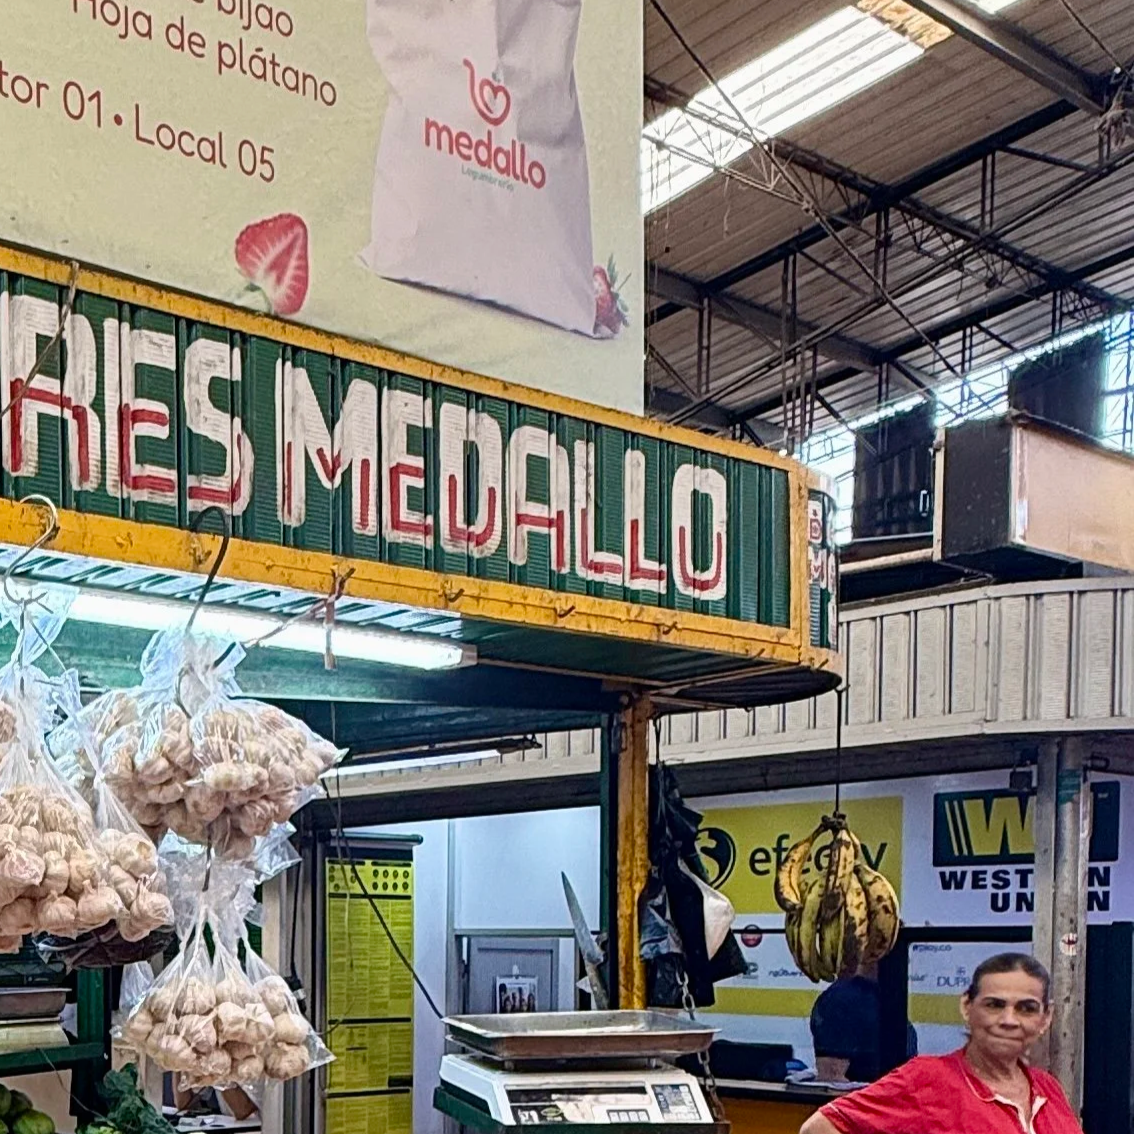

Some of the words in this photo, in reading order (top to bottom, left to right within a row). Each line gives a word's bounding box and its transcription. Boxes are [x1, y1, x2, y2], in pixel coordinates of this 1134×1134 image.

[165, 16, 206, 58] de
[218, 38, 336, 106] plátano
[63, 81, 102, 128] 01
[135, 103, 227, 168] Local
[238, 139, 275, 182] 05
[424, 117, 546, 189] medallo
[276, 357, 728, 601] MEDALLO
[939, 866, 1111, 891] WESTN
[990, 890, 1111, 913] UNN
